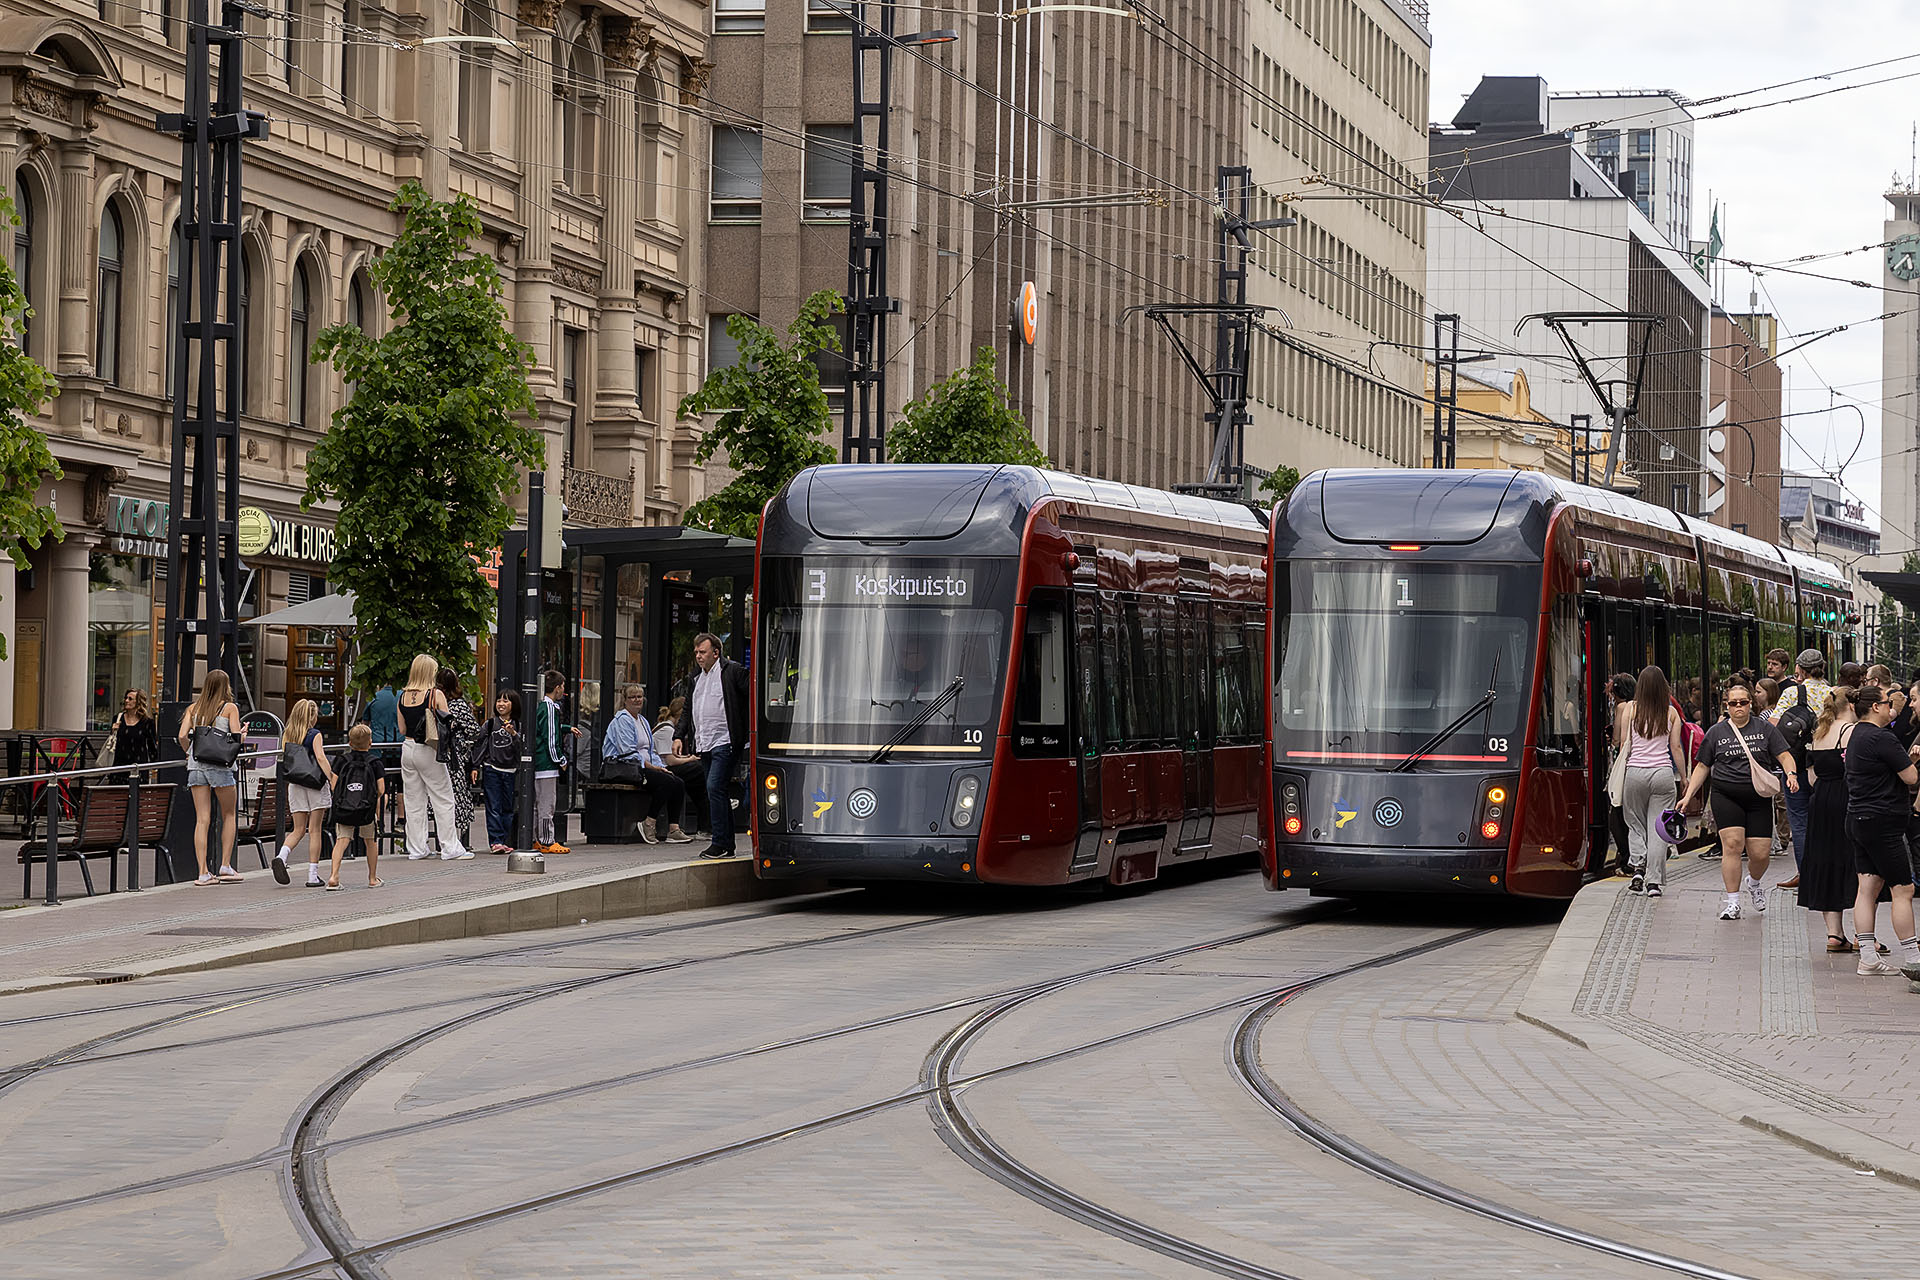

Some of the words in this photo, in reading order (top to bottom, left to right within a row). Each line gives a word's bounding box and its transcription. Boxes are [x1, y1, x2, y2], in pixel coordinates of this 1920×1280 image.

[115, 498, 169, 538] KEOP
[118, 537, 168, 558] OPTIIKK
[264, 519, 299, 558] CIAL
[302, 525, 338, 562] BURG
[808, 569, 827, 600] 3
[855, 574, 967, 600] Koskipuisto
[1396, 579, 1414, 606] 1
[963, 729, 983, 743] 10
[1488, 737, 1508, 752] 03
[1717, 738, 1731, 746] LOS
[1734, 733, 1764, 743] AGELES
[1725, 747, 1761, 756] CALIFONIA
